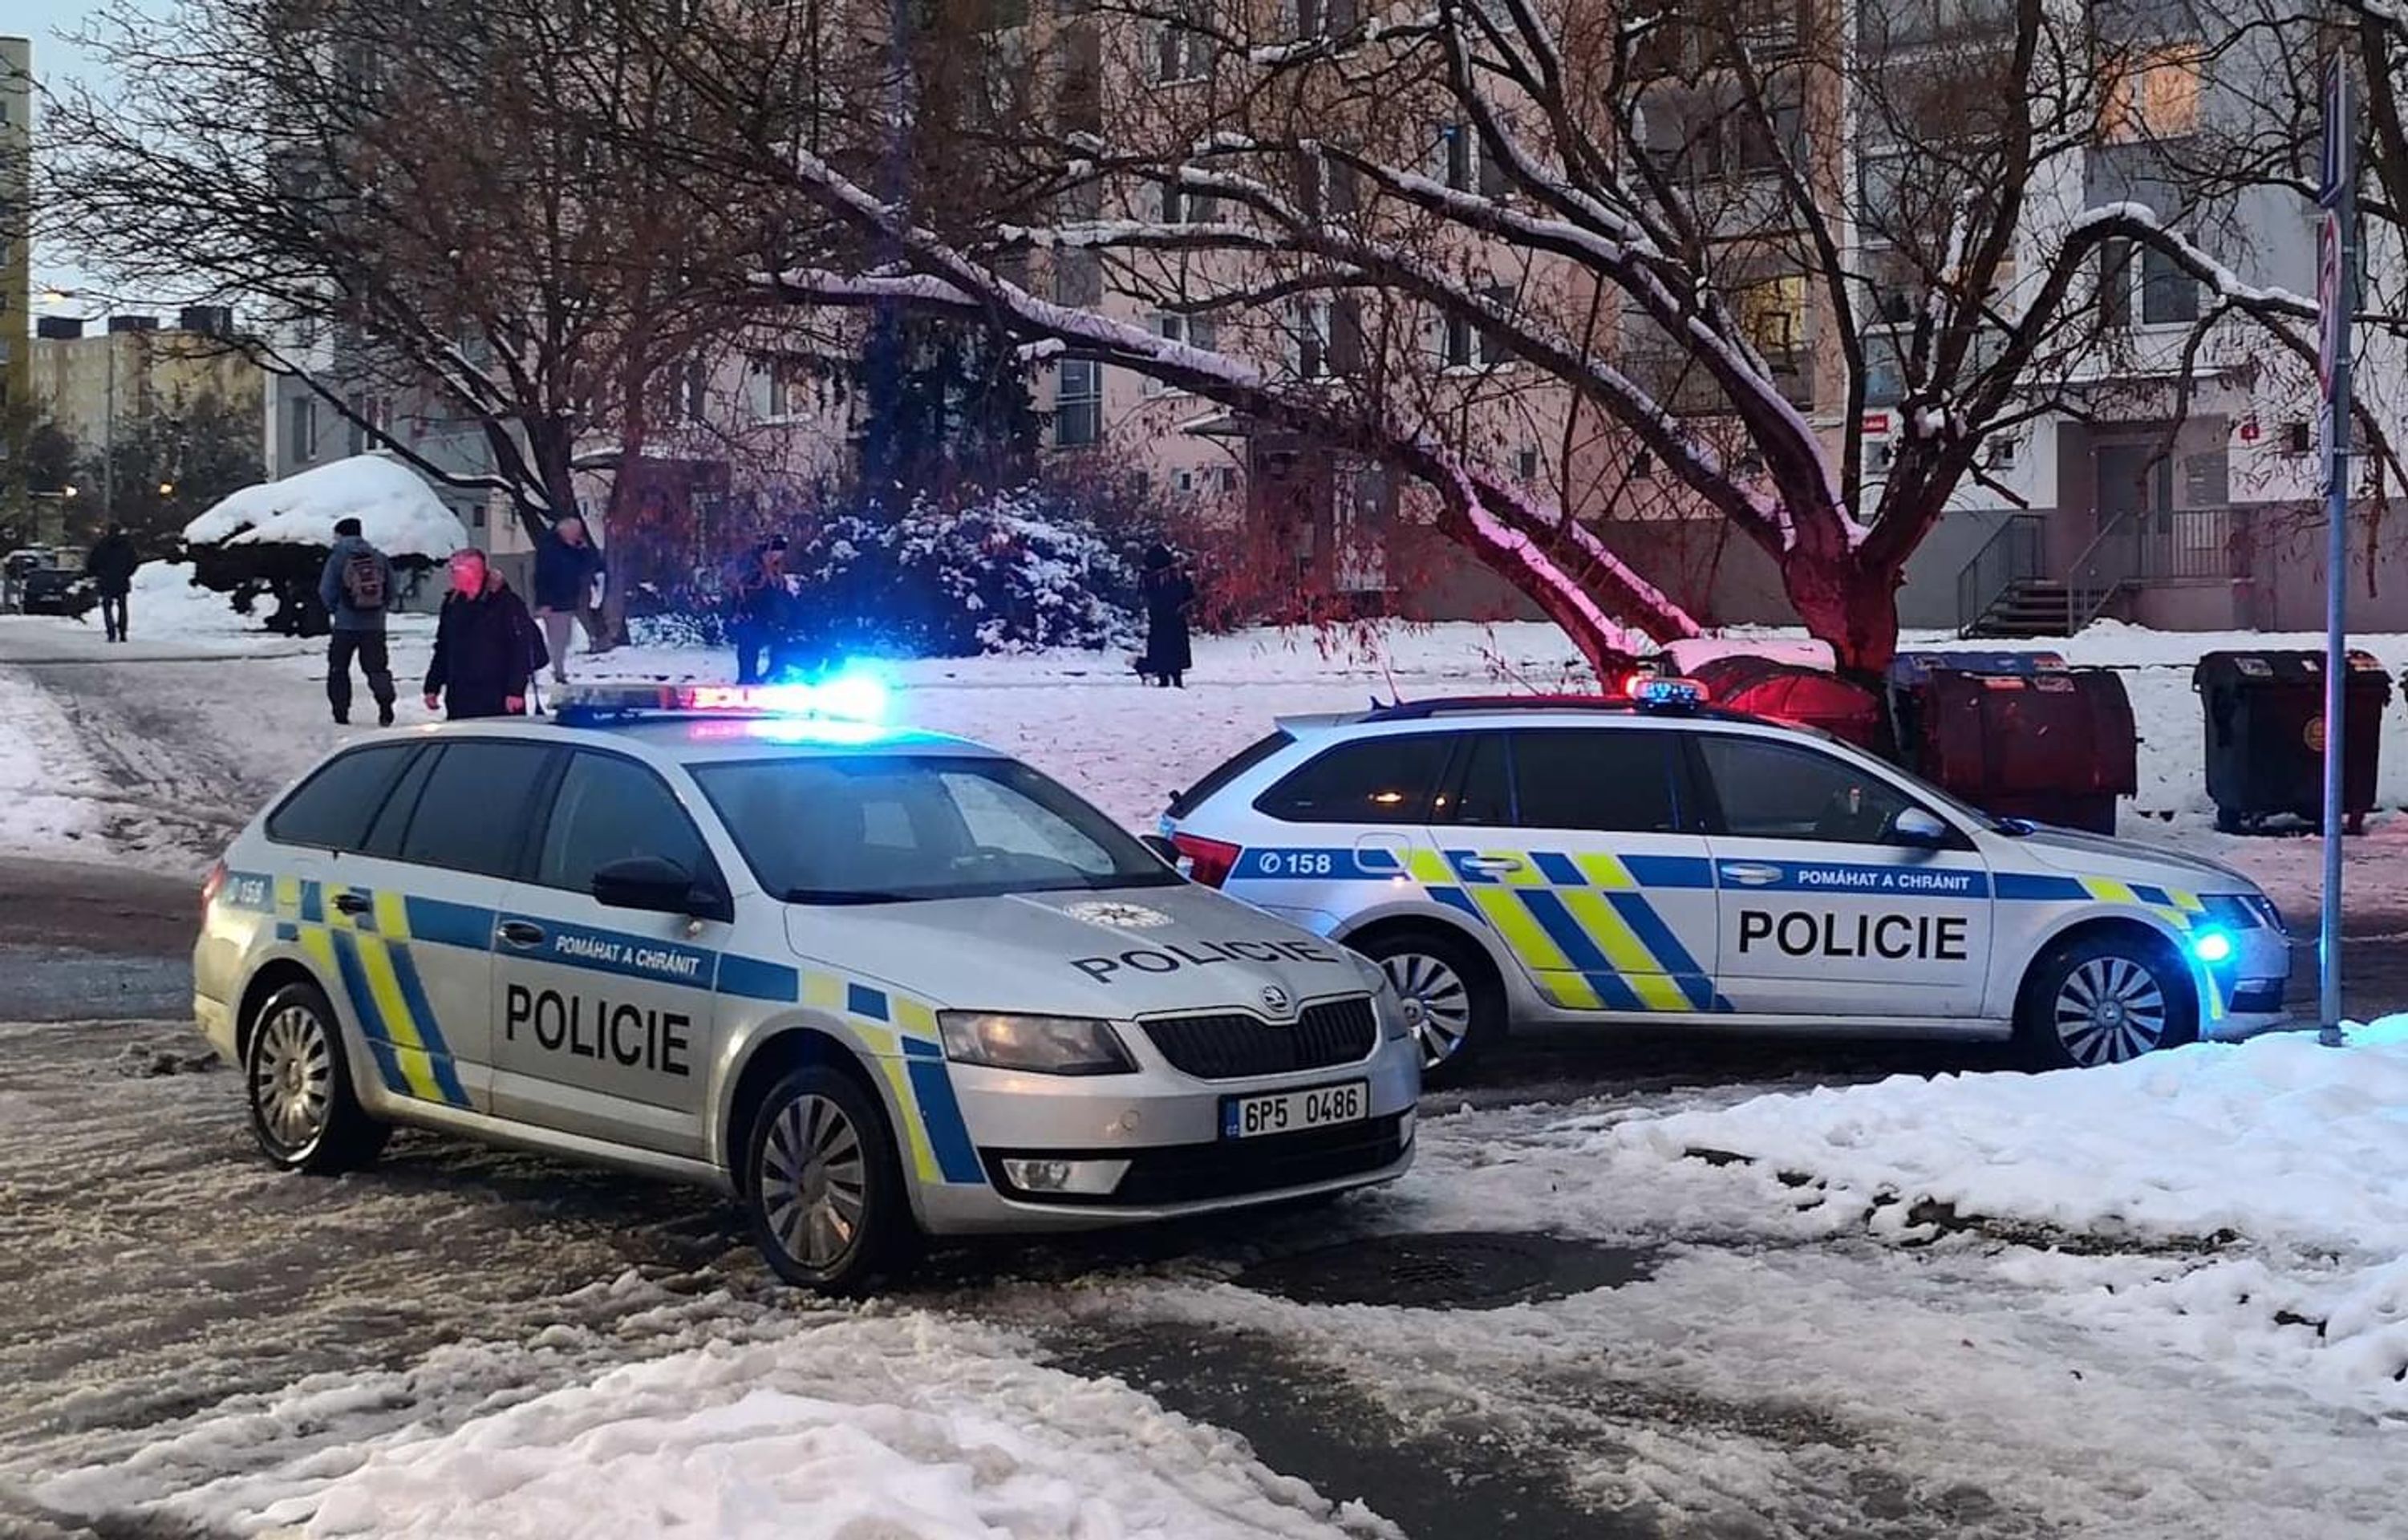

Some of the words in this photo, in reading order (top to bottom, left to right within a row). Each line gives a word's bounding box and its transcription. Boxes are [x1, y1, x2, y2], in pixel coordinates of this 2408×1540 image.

[1287, 853, 1332, 874] 158
[1798, 869, 1878, 886] POMÁHAT
[1882, 873, 1894, 886] A
[1899, 873, 1971, 890] CHRÁNIT
[555, 934, 621, 962] POMÁHAT
[622, 947, 633, 964] A
[635, 949, 700, 975] CHRÁNIT
[1739, 910, 1968, 960] POLICIE
[1071, 940, 1338, 984] POLICIE
[507, 983, 690, 1076] POLICIE
[1246, 1097, 1287, 1133] 6P5
[1306, 1088, 1357, 1124] 0486
